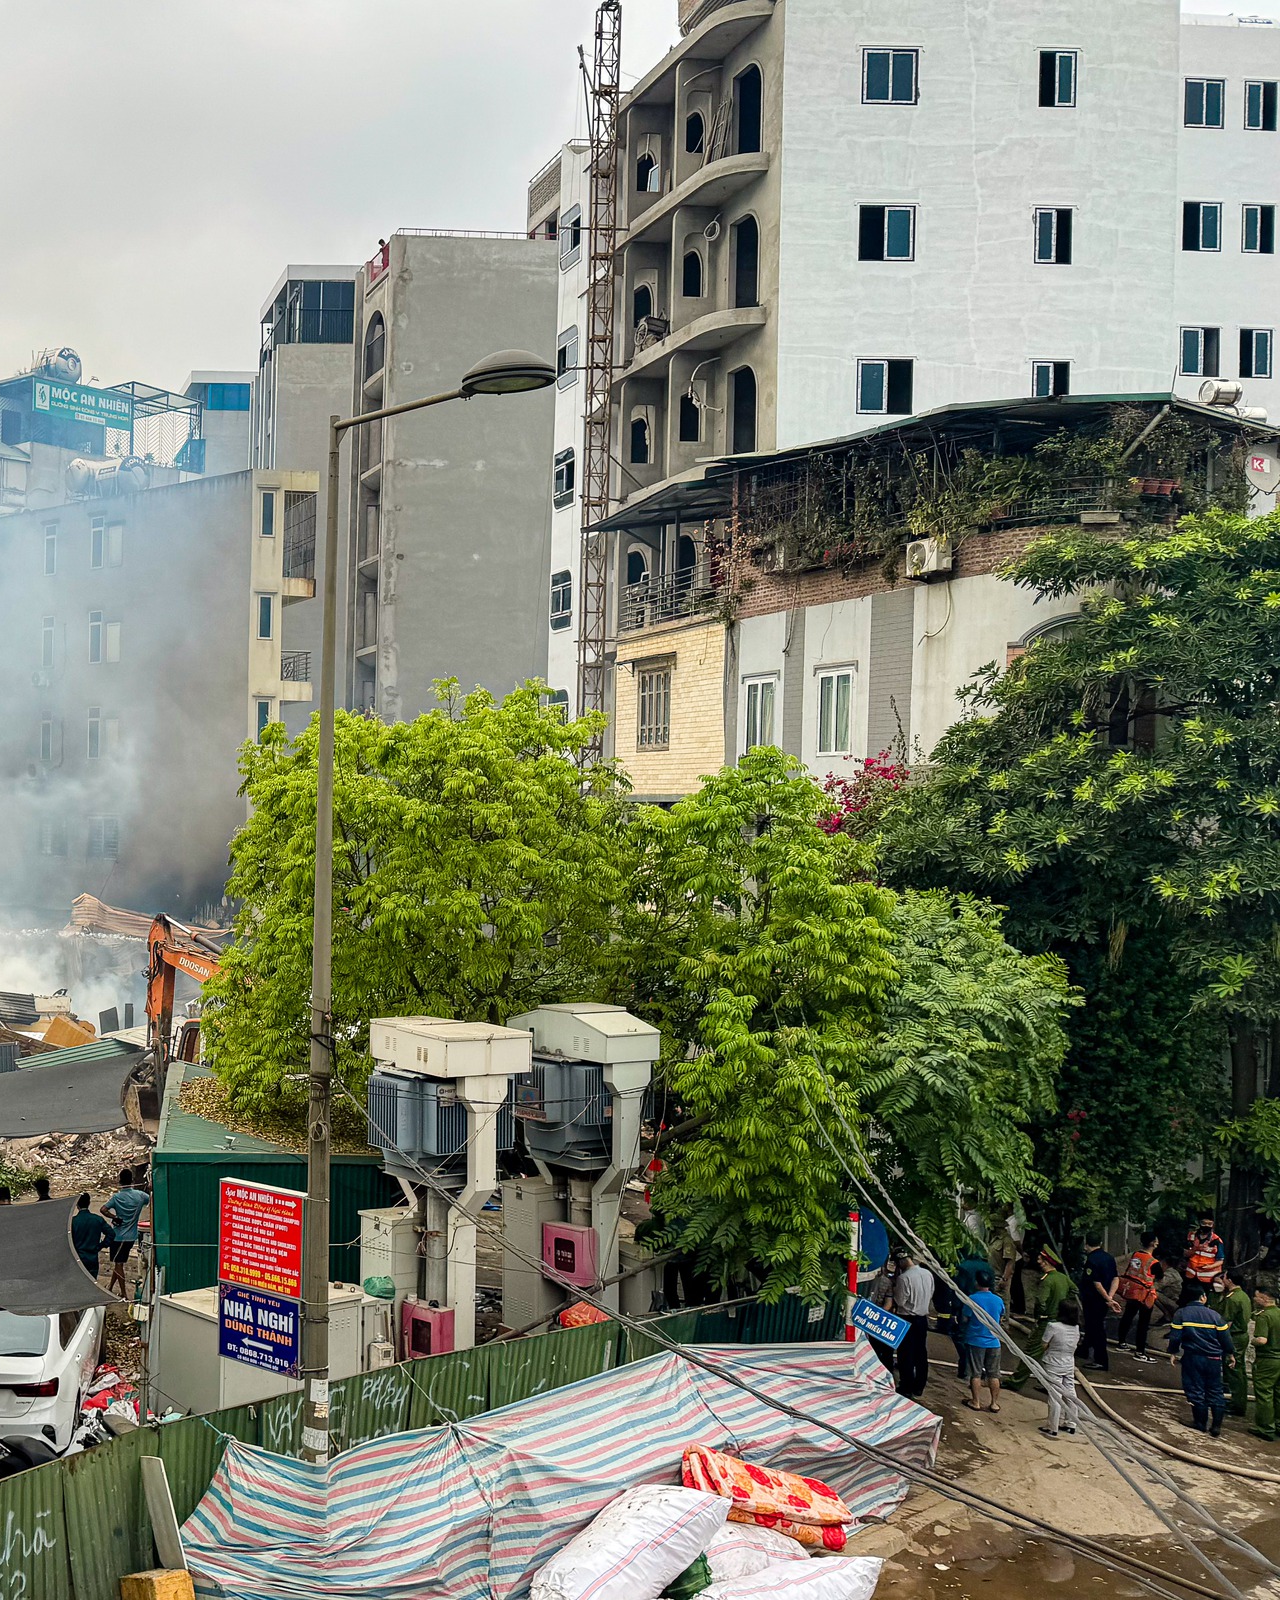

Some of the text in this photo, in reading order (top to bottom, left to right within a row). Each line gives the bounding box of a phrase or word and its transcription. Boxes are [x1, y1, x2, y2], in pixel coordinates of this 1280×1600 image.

[52, 387, 128, 413] MỘC AN NHIÊN
[179, 957, 210, 977] DOOSAN
[226, 1187, 274, 1205] Spa MỘC AN NHIÊN
[224, 1298, 294, 1334] NHÀ NGHỈ
[225, 1318, 254, 1335] DŨNG
[863, 1306, 898, 1330] Ngõ 116
